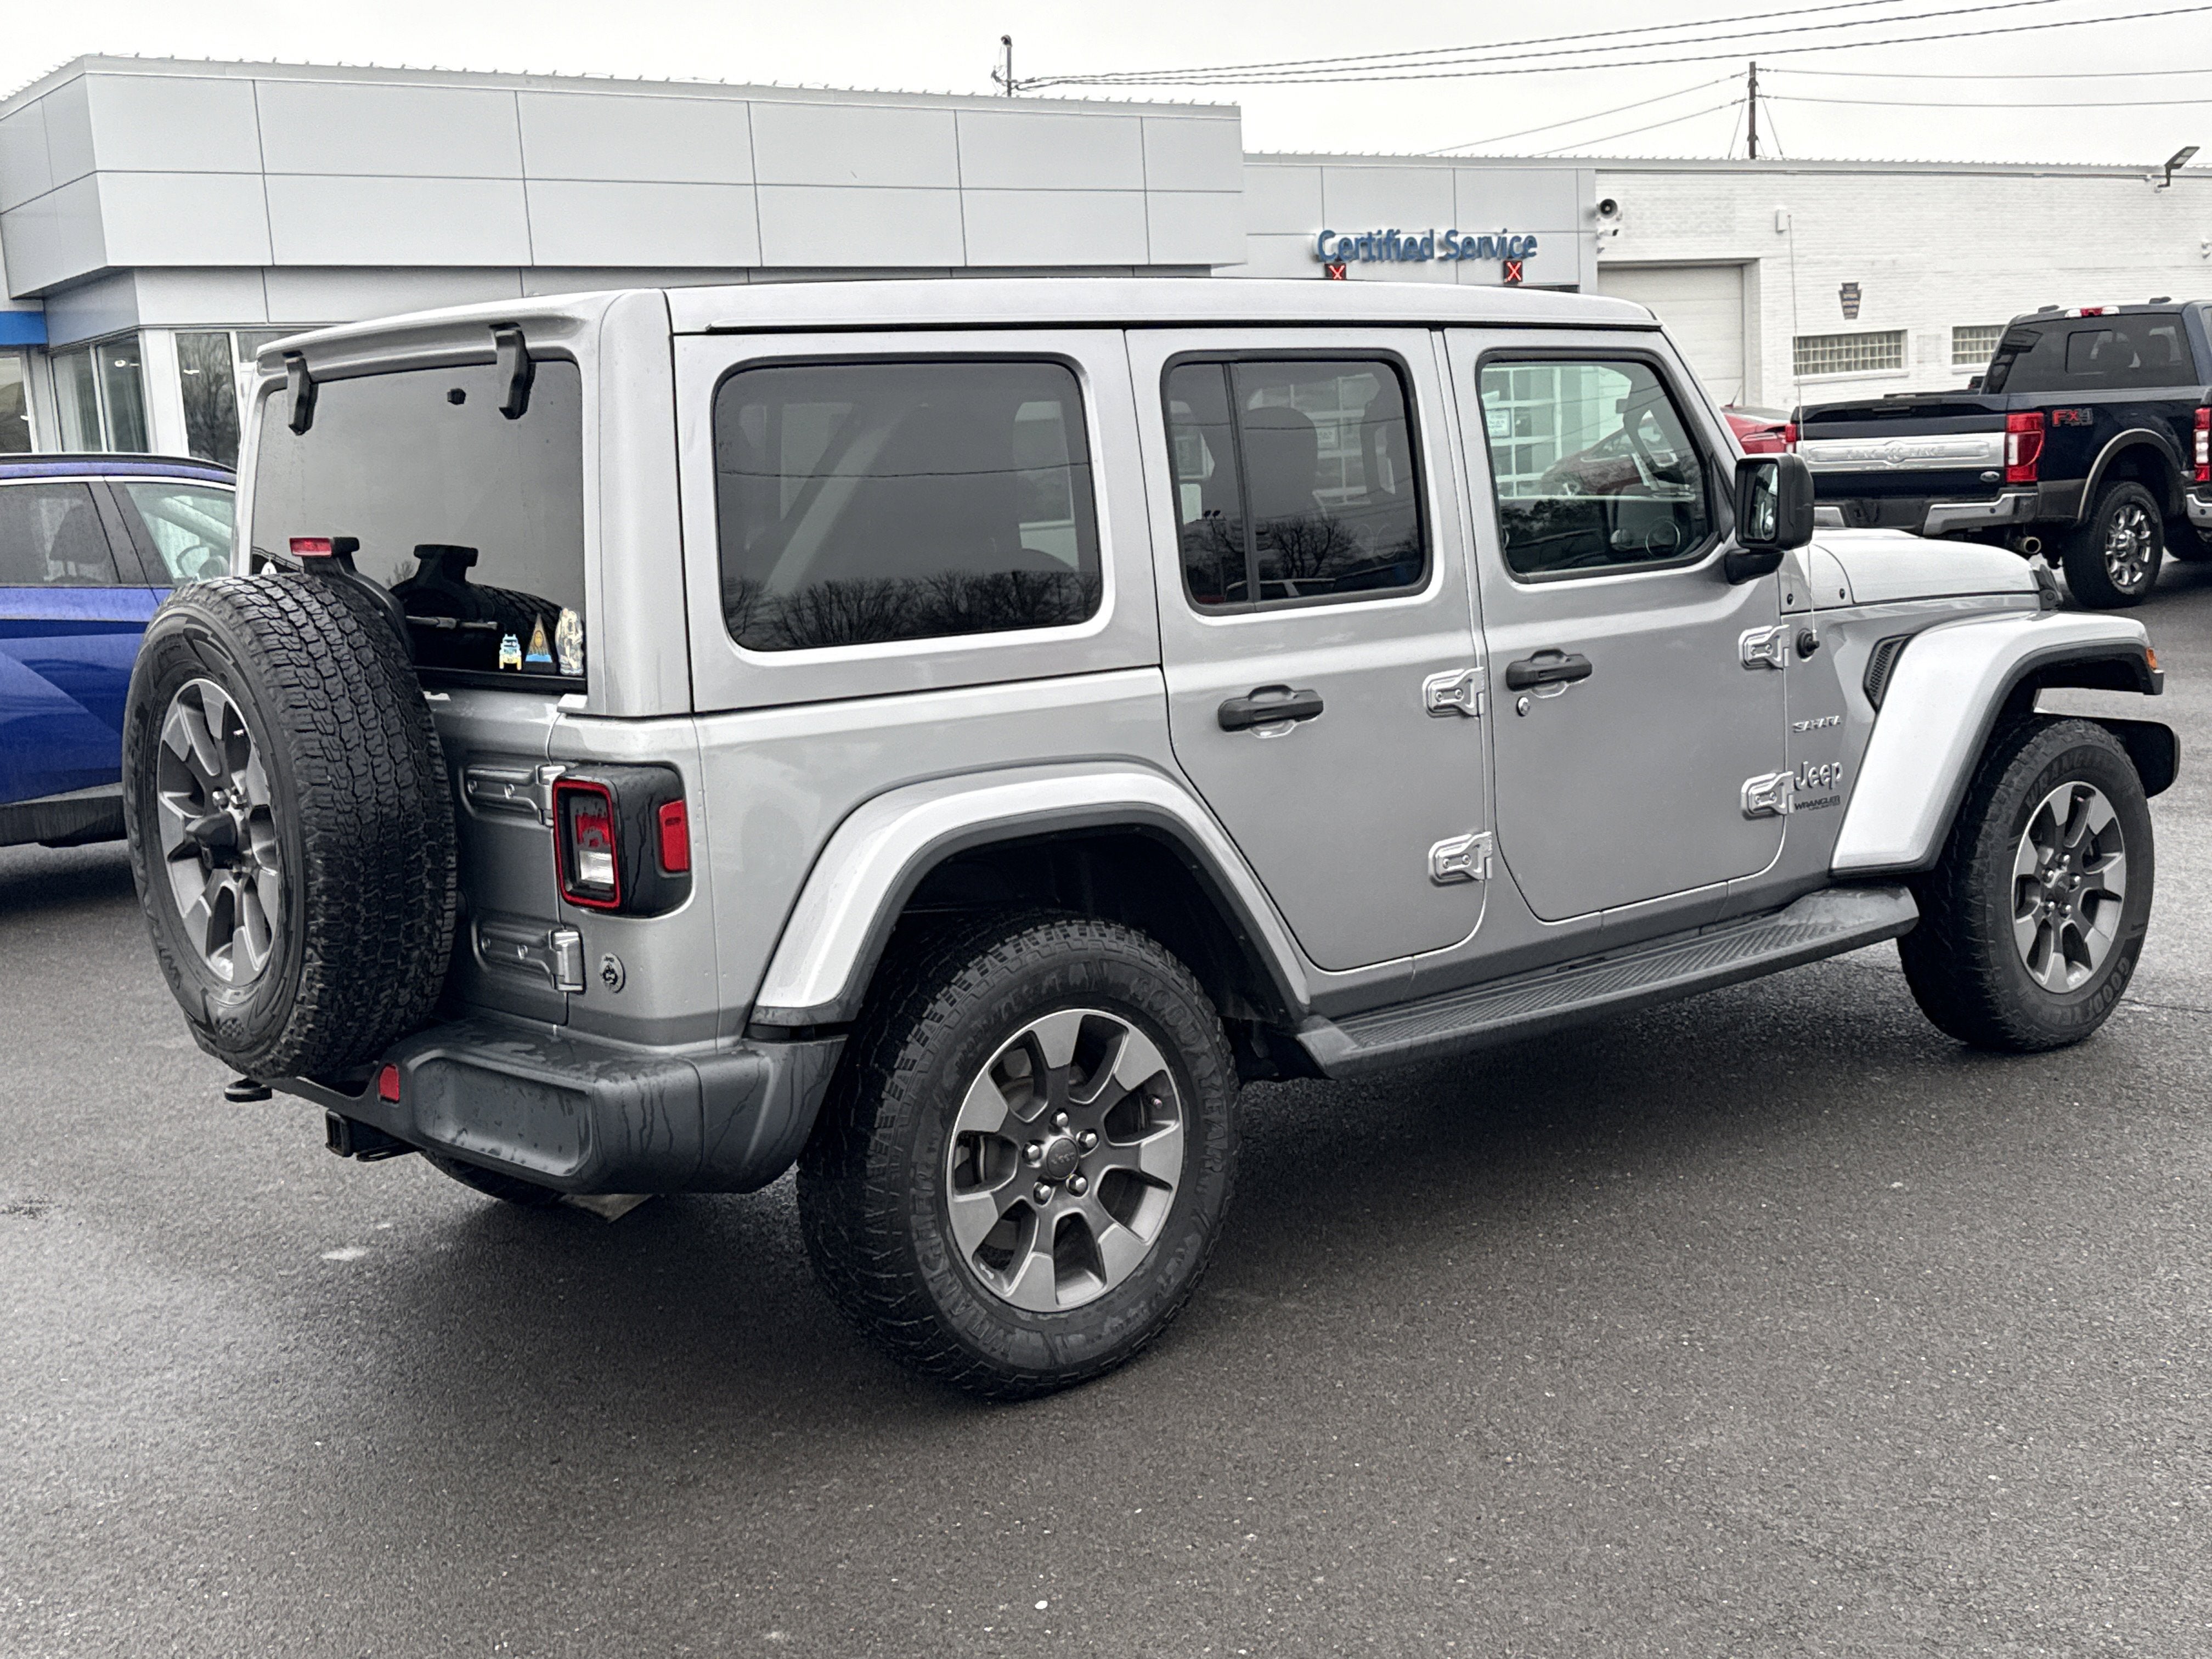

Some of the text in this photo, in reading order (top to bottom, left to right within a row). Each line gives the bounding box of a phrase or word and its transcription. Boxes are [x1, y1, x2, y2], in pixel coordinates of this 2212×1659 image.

[1318, 228, 1538, 261] Certified Service
[2052, 408, 2092, 426] FX4
[1794, 760, 1843, 791] Jeep
[1794, 794, 1841, 810] WRANGLER
[1131, 976, 1225, 1173] GOODYEAR
